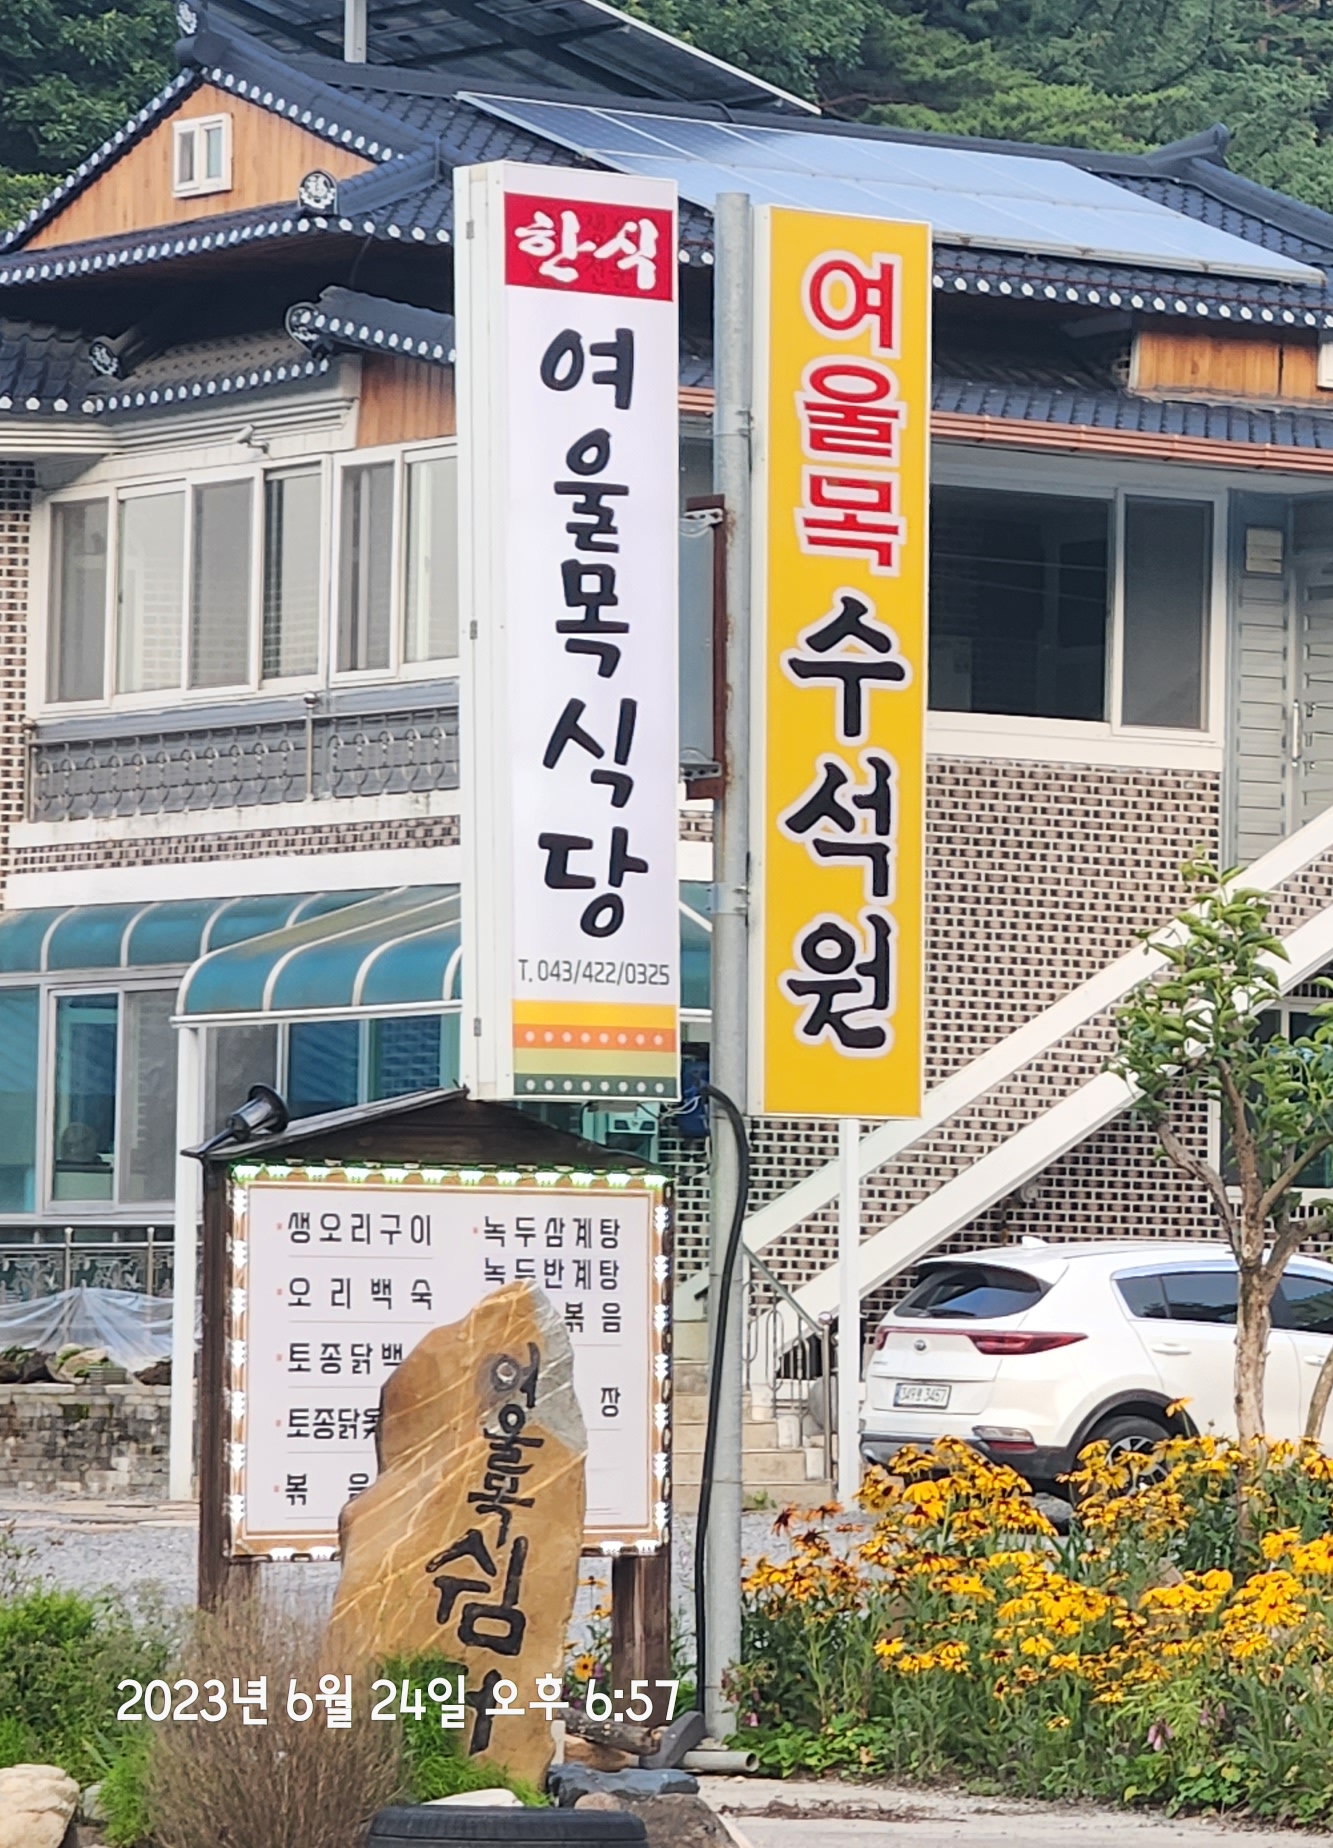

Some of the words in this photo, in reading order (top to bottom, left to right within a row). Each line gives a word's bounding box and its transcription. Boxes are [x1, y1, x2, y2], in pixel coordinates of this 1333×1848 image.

[514, 210, 659, 291] 한식
[804, 258, 900, 570] 여울목
[538, 328, 649, 938] 여울목식당
[785, 595, 906, 1049] 수석원
[537, 959, 670, 986] 043/422/0325
[287, 1212, 431, 1246] 생오리구이
[484, 1216, 621, 1249] 녹두삼계탕
